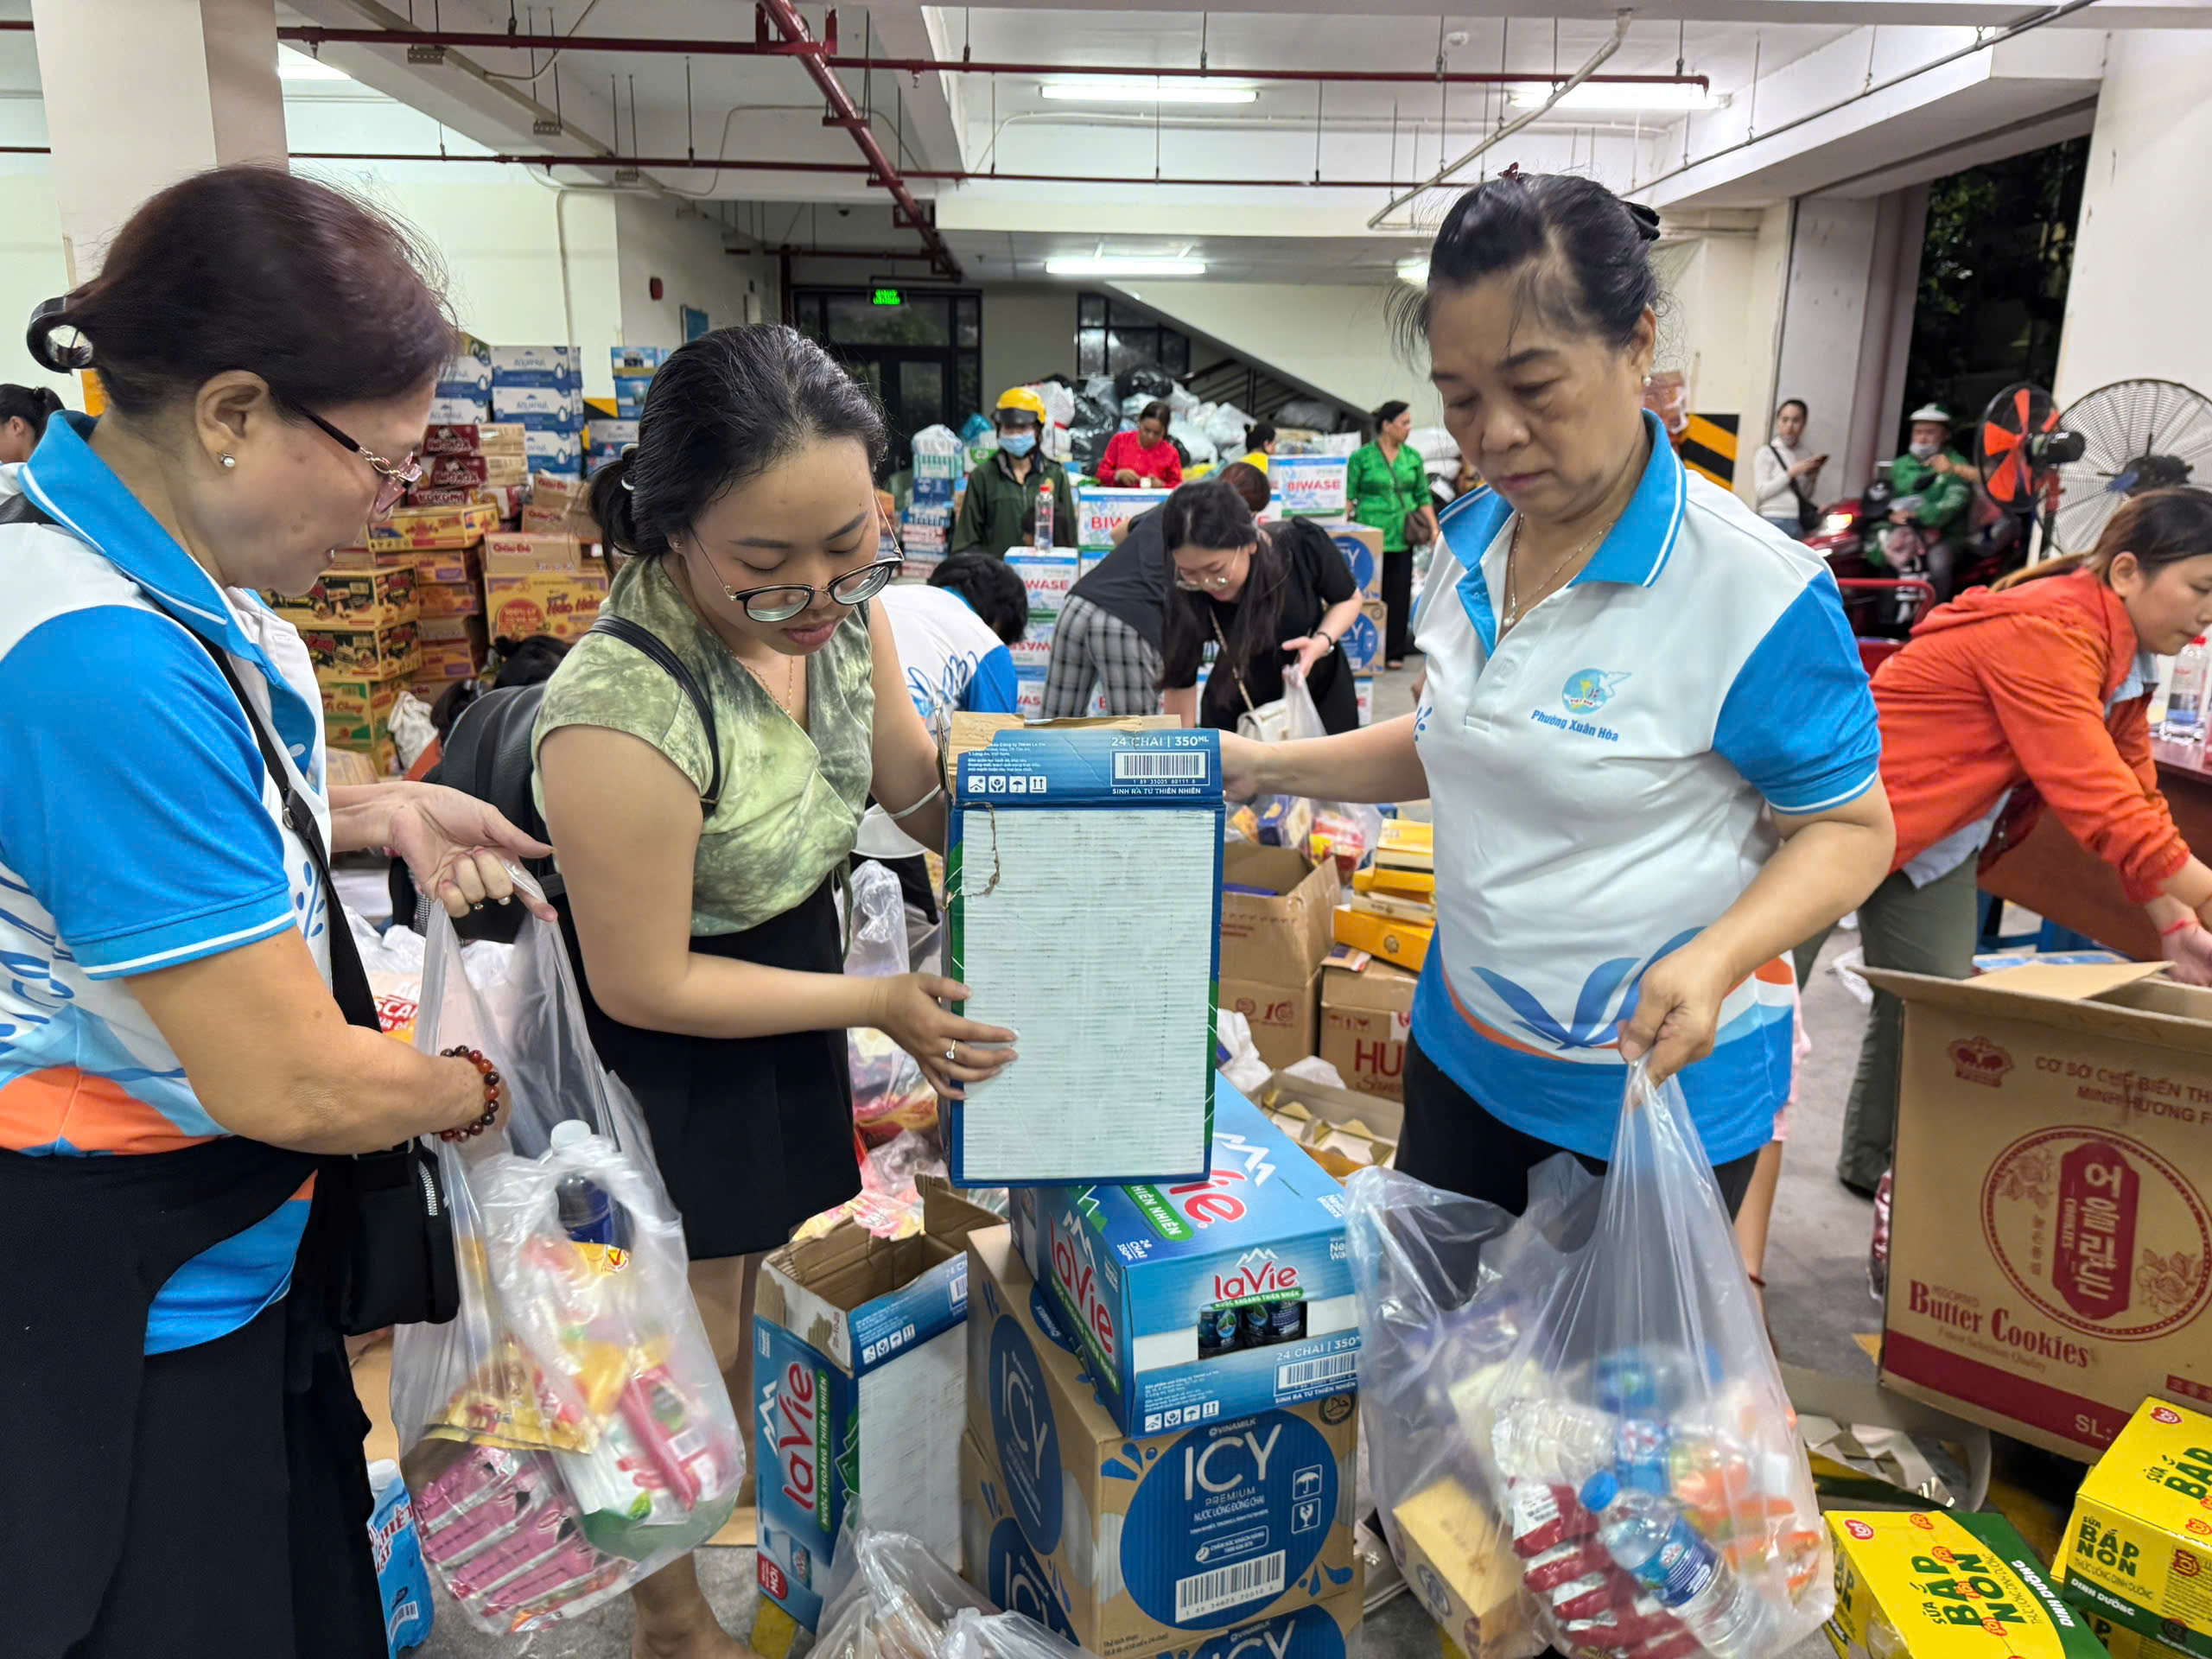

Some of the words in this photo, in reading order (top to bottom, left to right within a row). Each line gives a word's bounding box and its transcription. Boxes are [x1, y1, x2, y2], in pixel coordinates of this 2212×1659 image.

[1287, 480, 1341, 492] BIWASE
[1091, 516, 1128, 531] BIW
[1025, 580, 1070, 591] WASE
[1111, 737, 1127, 747] 24
[1132, 736, 1163, 747] CHAI
[1530, 709, 1568, 729] Phường
[1568, 719, 1597, 737] Xuân
[1597, 727, 1619, 742] Hòa
[2035, 1056, 2063, 1073] CƠ
[2066, 1061, 2094, 1079] SỞ
[1131, 1185, 1159, 1206] HIÊN
[1149, 1205, 1183, 1236] NHIÊN
[1215, 1261, 1299, 1300] laVie
[1908, 1279, 1983, 1334] Butter
[1991, 1307, 2088, 1369] Cookies
[1276, 1350, 1290, 1361] 24
[1294, 1344, 1324, 1357] CHAI
[779, 1362, 814, 1510] laVie
[2075, 1414, 2113, 1441] SL:
[1185, 1423, 1283, 1500] ICY
[1205, 1485, 1256, 1506] PREMIUM
[2079, 1523, 2139, 1559] BẮP
[2076, 1539, 2137, 1577] NON
[1909, 1555, 1984, 1627] BẮP
[1952, 1554, 2028, 1624] NON
[2012, 1560, 2056, 1599] DƯỠNG
[1922, 1600, 1948, 1625] SỮA
[2049, 1599, 2075, 1627] DINH
